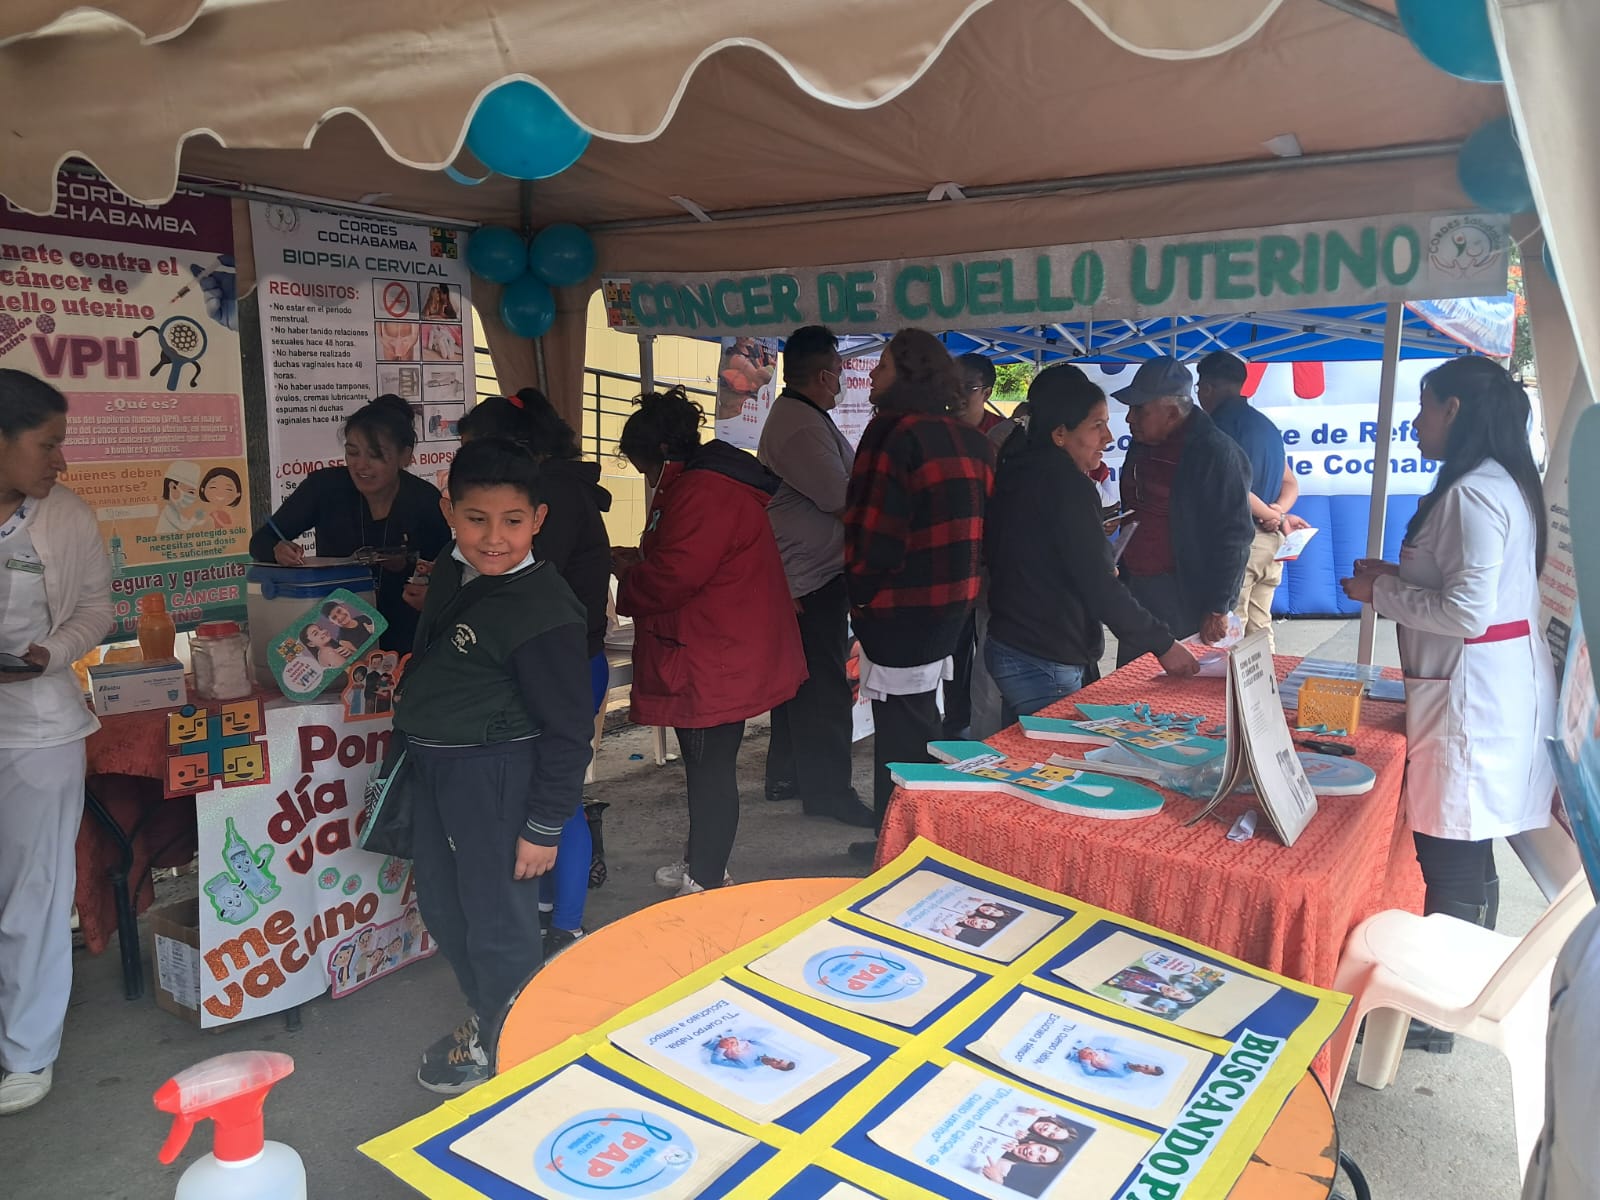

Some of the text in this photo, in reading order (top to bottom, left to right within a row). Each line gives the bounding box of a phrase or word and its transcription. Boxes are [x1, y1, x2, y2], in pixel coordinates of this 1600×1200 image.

[57, 181, 160, 210] CORD
[339, 219, 398, 237] CORDES
[318, 230, 418, 252] COCHABAMBA
[0, 243, 179, 277] nate contra el
[283, 248, 448, 277] BIOPSIA CERVICAL
[98, 273, 129, 295] de
[630, 224, 1421, 330] CANCER DE CUELLO UTERINO
[269, 280, 360, 300] REQUISITOS:
[62, 299, 156, 320] uterino
[273, 303, 285, 311] No
[286, 303, 305, 312] estar
[306, 305, 316, 313] en
[317, 305, 324, 313] el
[270, 315, 309, 324] menstrual.
[271, 337, 304, 345] sexuales
[274, 326, 286, 334] No
[287, 326, 309, 334] haber
[334, 328, 369, 336] relaciones
[0, 333, 27, 358] ontra
[31, 333, 141, 379] VPH
[276, 349, 351, 358] No haberse realizado
[273, 360, 300, 368] duchas
[301, 361, 336, 369] vaginales
[277, 383, 289, 391] No
[335, 383, 371, 391] tampones,
[105, 398, 178, 412] ¿Qué es?
[275, 405, 308, 413] espumas
[318, 404, 344, 412] duchas
[303, 394, 330, 402] cremas
[276, 416, 311, 425] vaginales
[312, 415, 330, 423] hace
[1311, 422, 1348, 445] de
[121, 468, 162, 480] deben
[136, 535, 157, 543] Para
[186, 529, 228, 540] protegido
[149, 537, 236, 552] necesitas una dosis
[111, 562, 246, 595] egura y gratuita
[171, 585, 239, 608] CÁNCER
[298, 725, 393, 773] Pon
[268, 775, 347, 845] día
[286, 809, 367, 874] va
[203, 910, 296, 981] me
[203, 893, 379, 1019] vacuno
[847, 963, 888, 991] PAP
[692, 1019, 723, 1037] cuerpo
[588, 1131, 648, 1177] PAP
[925, 1153, 940, 1166] de
